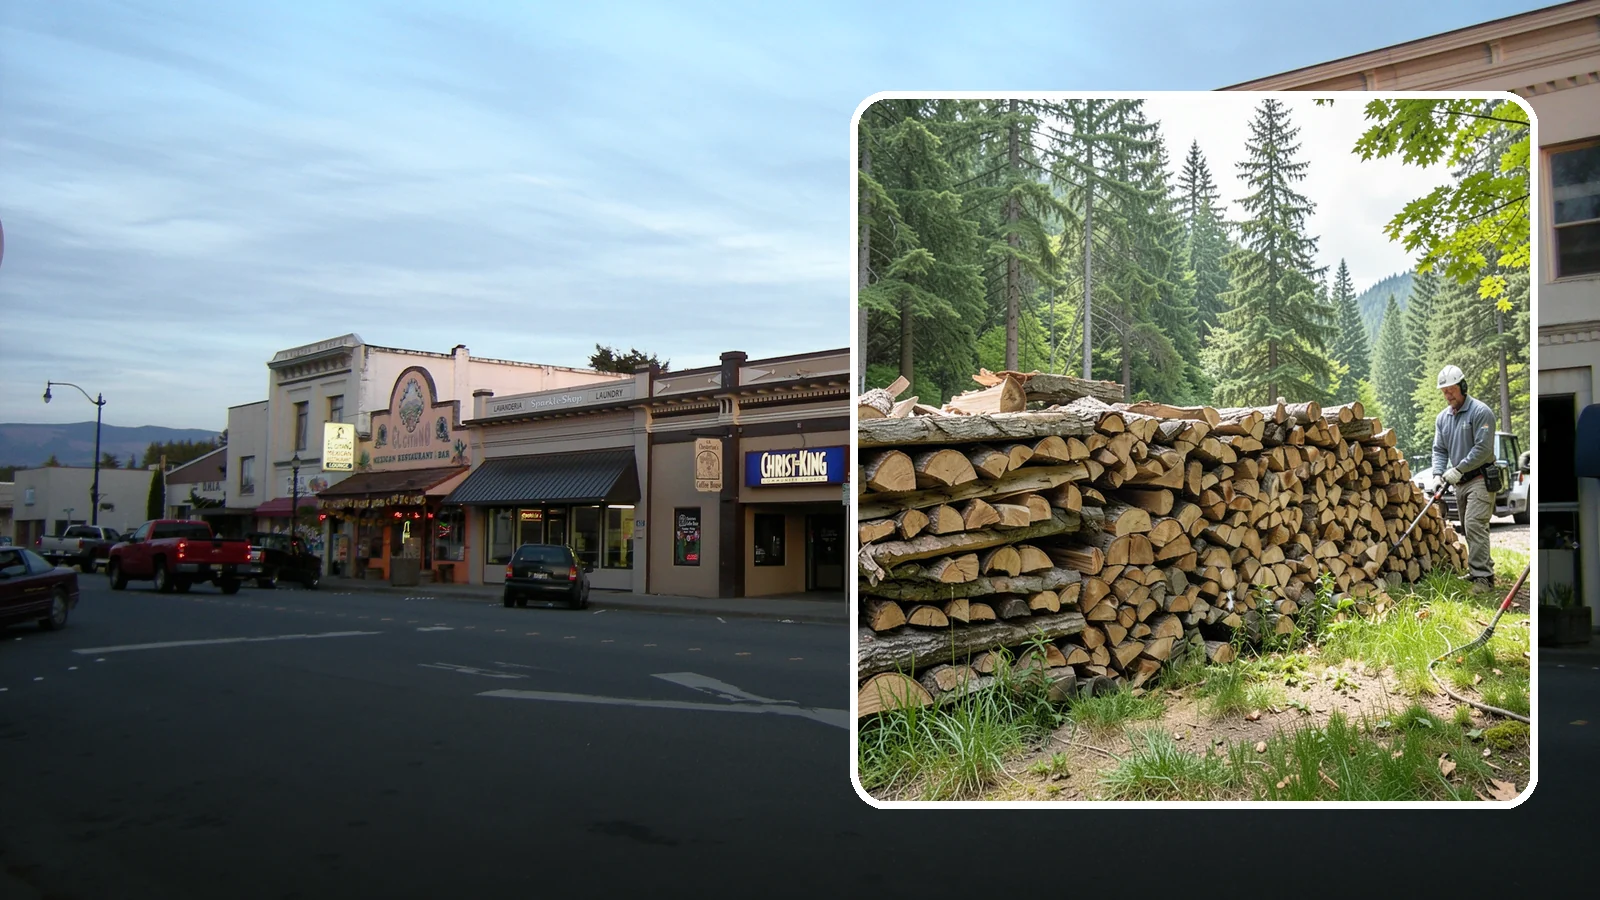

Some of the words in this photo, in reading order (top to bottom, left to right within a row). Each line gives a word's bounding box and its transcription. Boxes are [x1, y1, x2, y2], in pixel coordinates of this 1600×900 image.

[530, 396, 561, 409] Sparkle
[562, 394, 583, 405] Shop
[595, 389, 624, 400] LAUNDRY
[493, 402, 523, 413] LAVANDERIA
[373, 455, 396, 464] MEXICAN
[397, 451, 433, 462] RESTAURANT
[438, 450, 450, 458] BAR
[761, 452, 797, 478] CHRIST
[799, 450, 827, 476] KING
